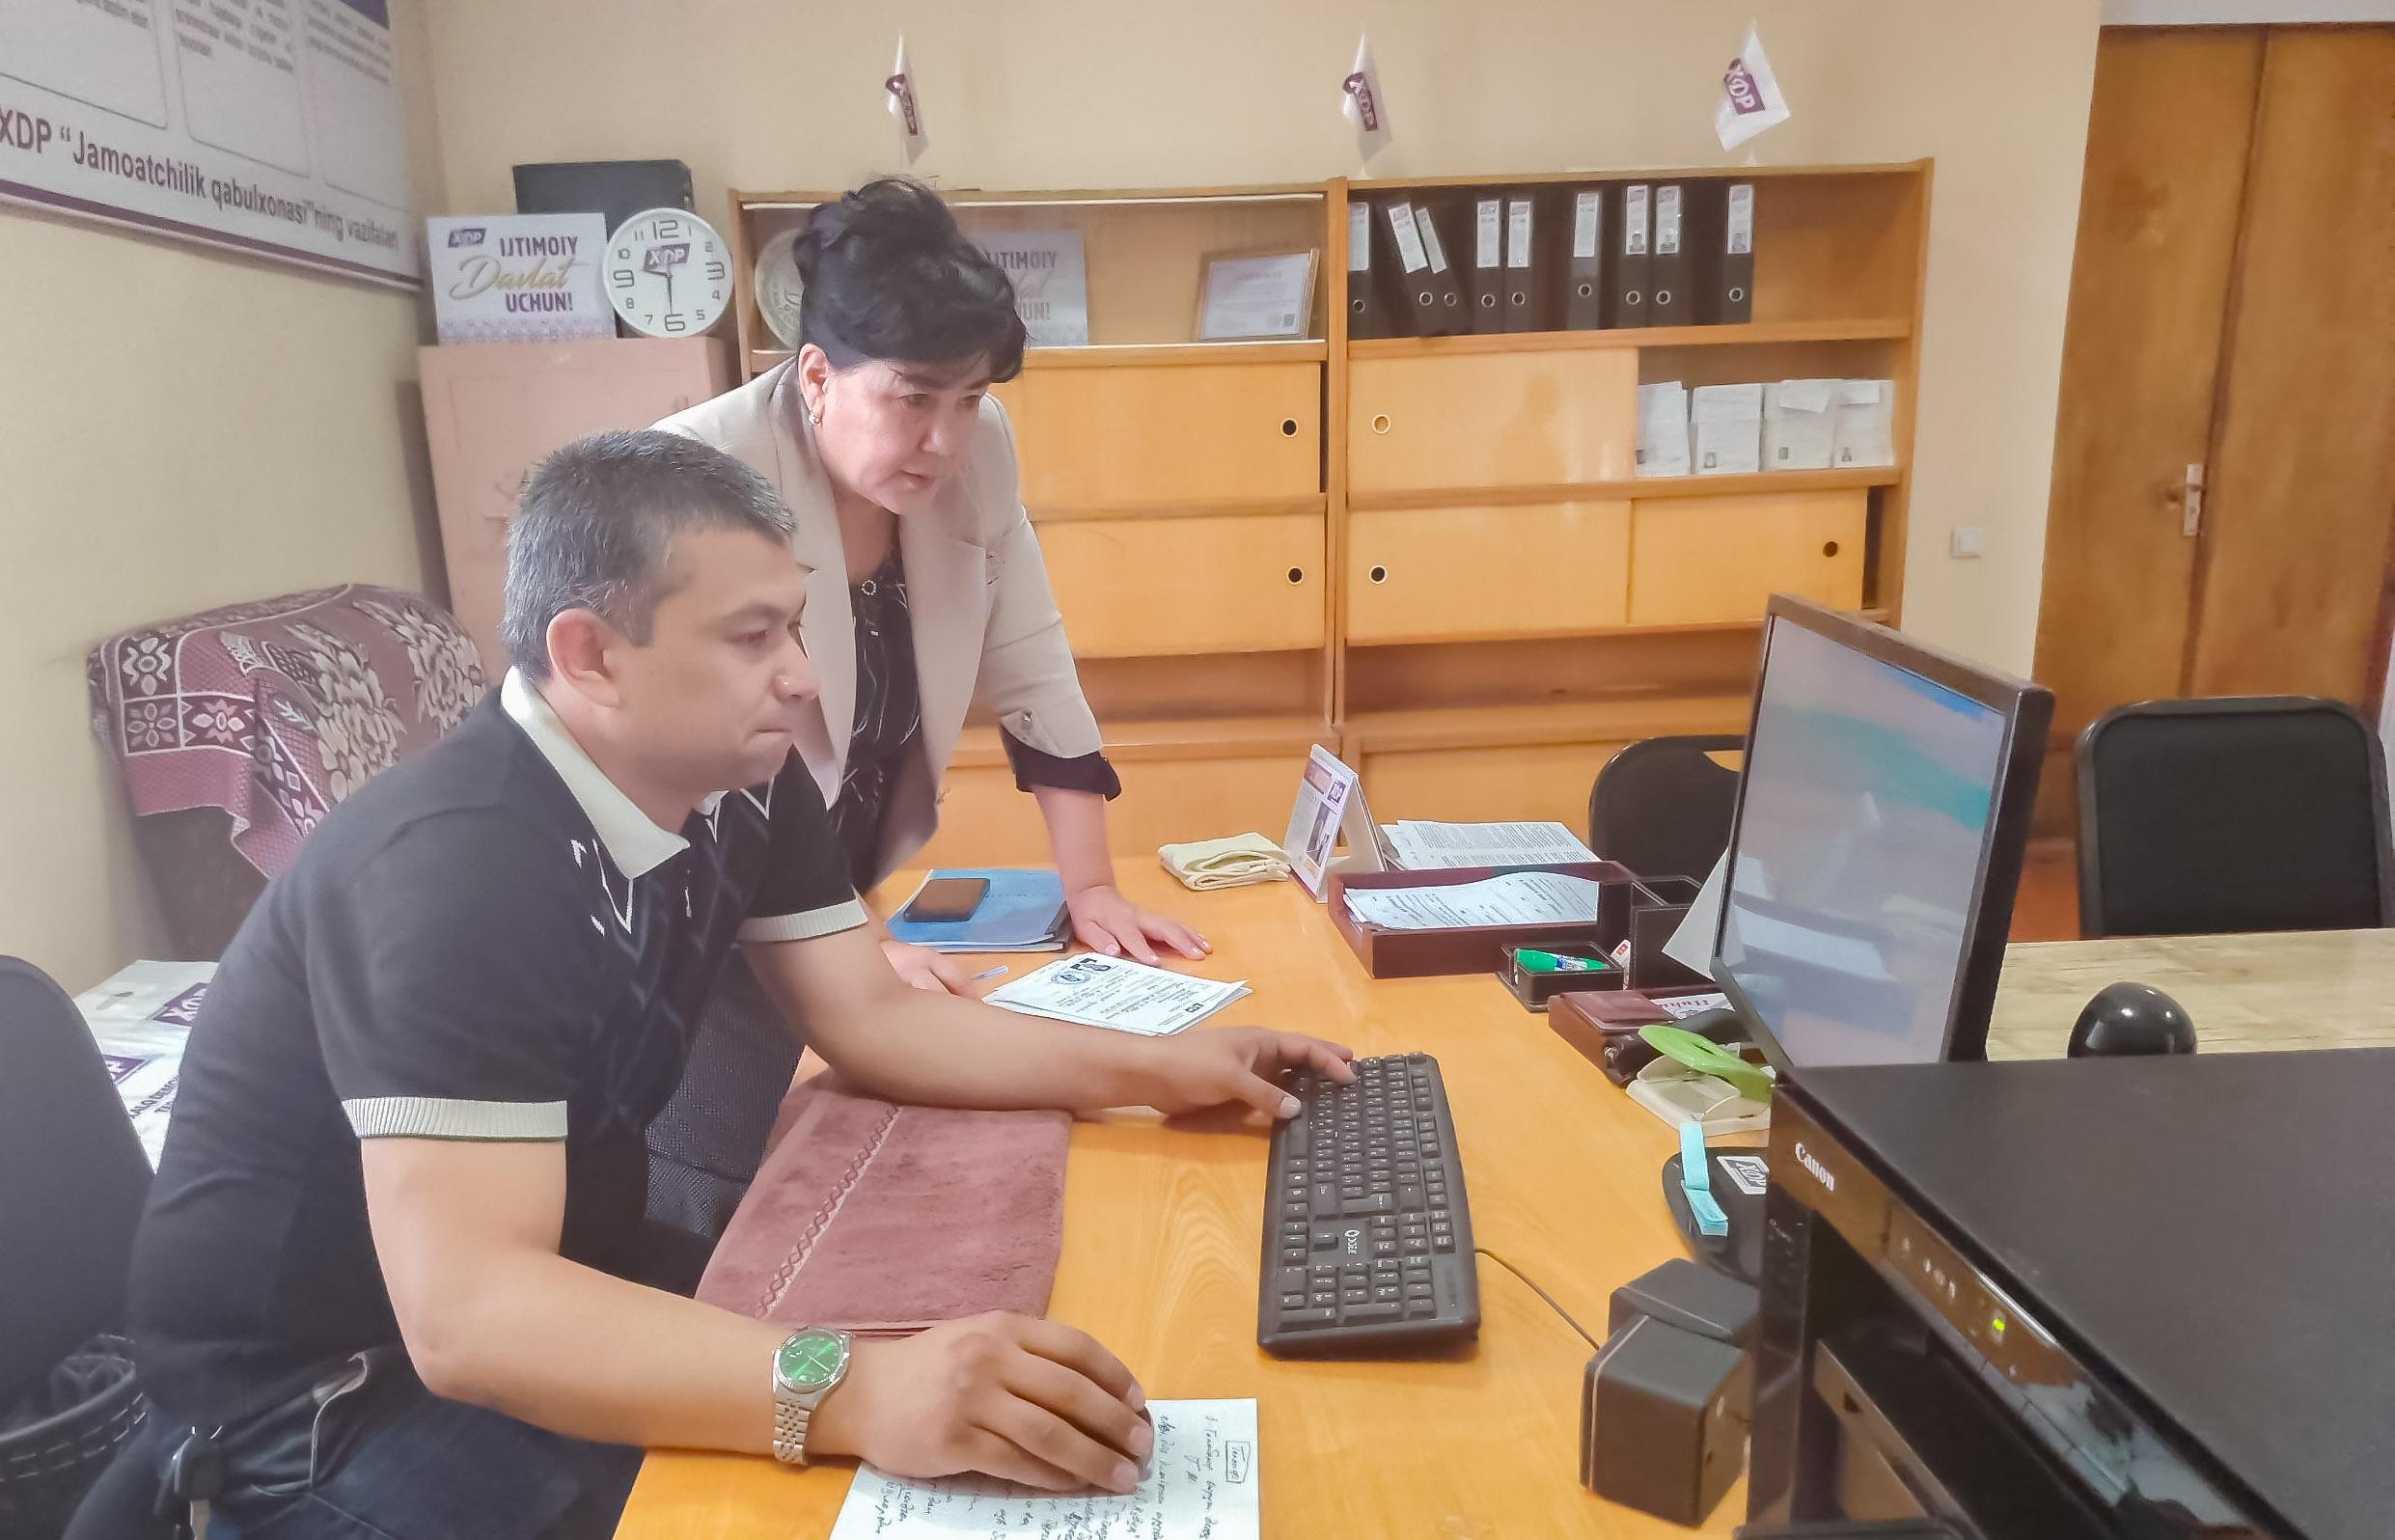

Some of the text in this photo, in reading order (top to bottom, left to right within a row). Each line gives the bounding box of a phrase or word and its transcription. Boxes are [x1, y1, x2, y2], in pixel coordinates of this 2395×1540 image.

[652, 219, 680, 241] 12
[613, 269, 635, 289] 9
[704, 261, 726, 281] 3
[505, 291, 574, 314] UCHUN!
[645, 314, 653, 325] 7
[664, 313, 686, 332] 6
[696, 309, 705, 320] 5
[1795, 1141, 1835, 1192] Canon
